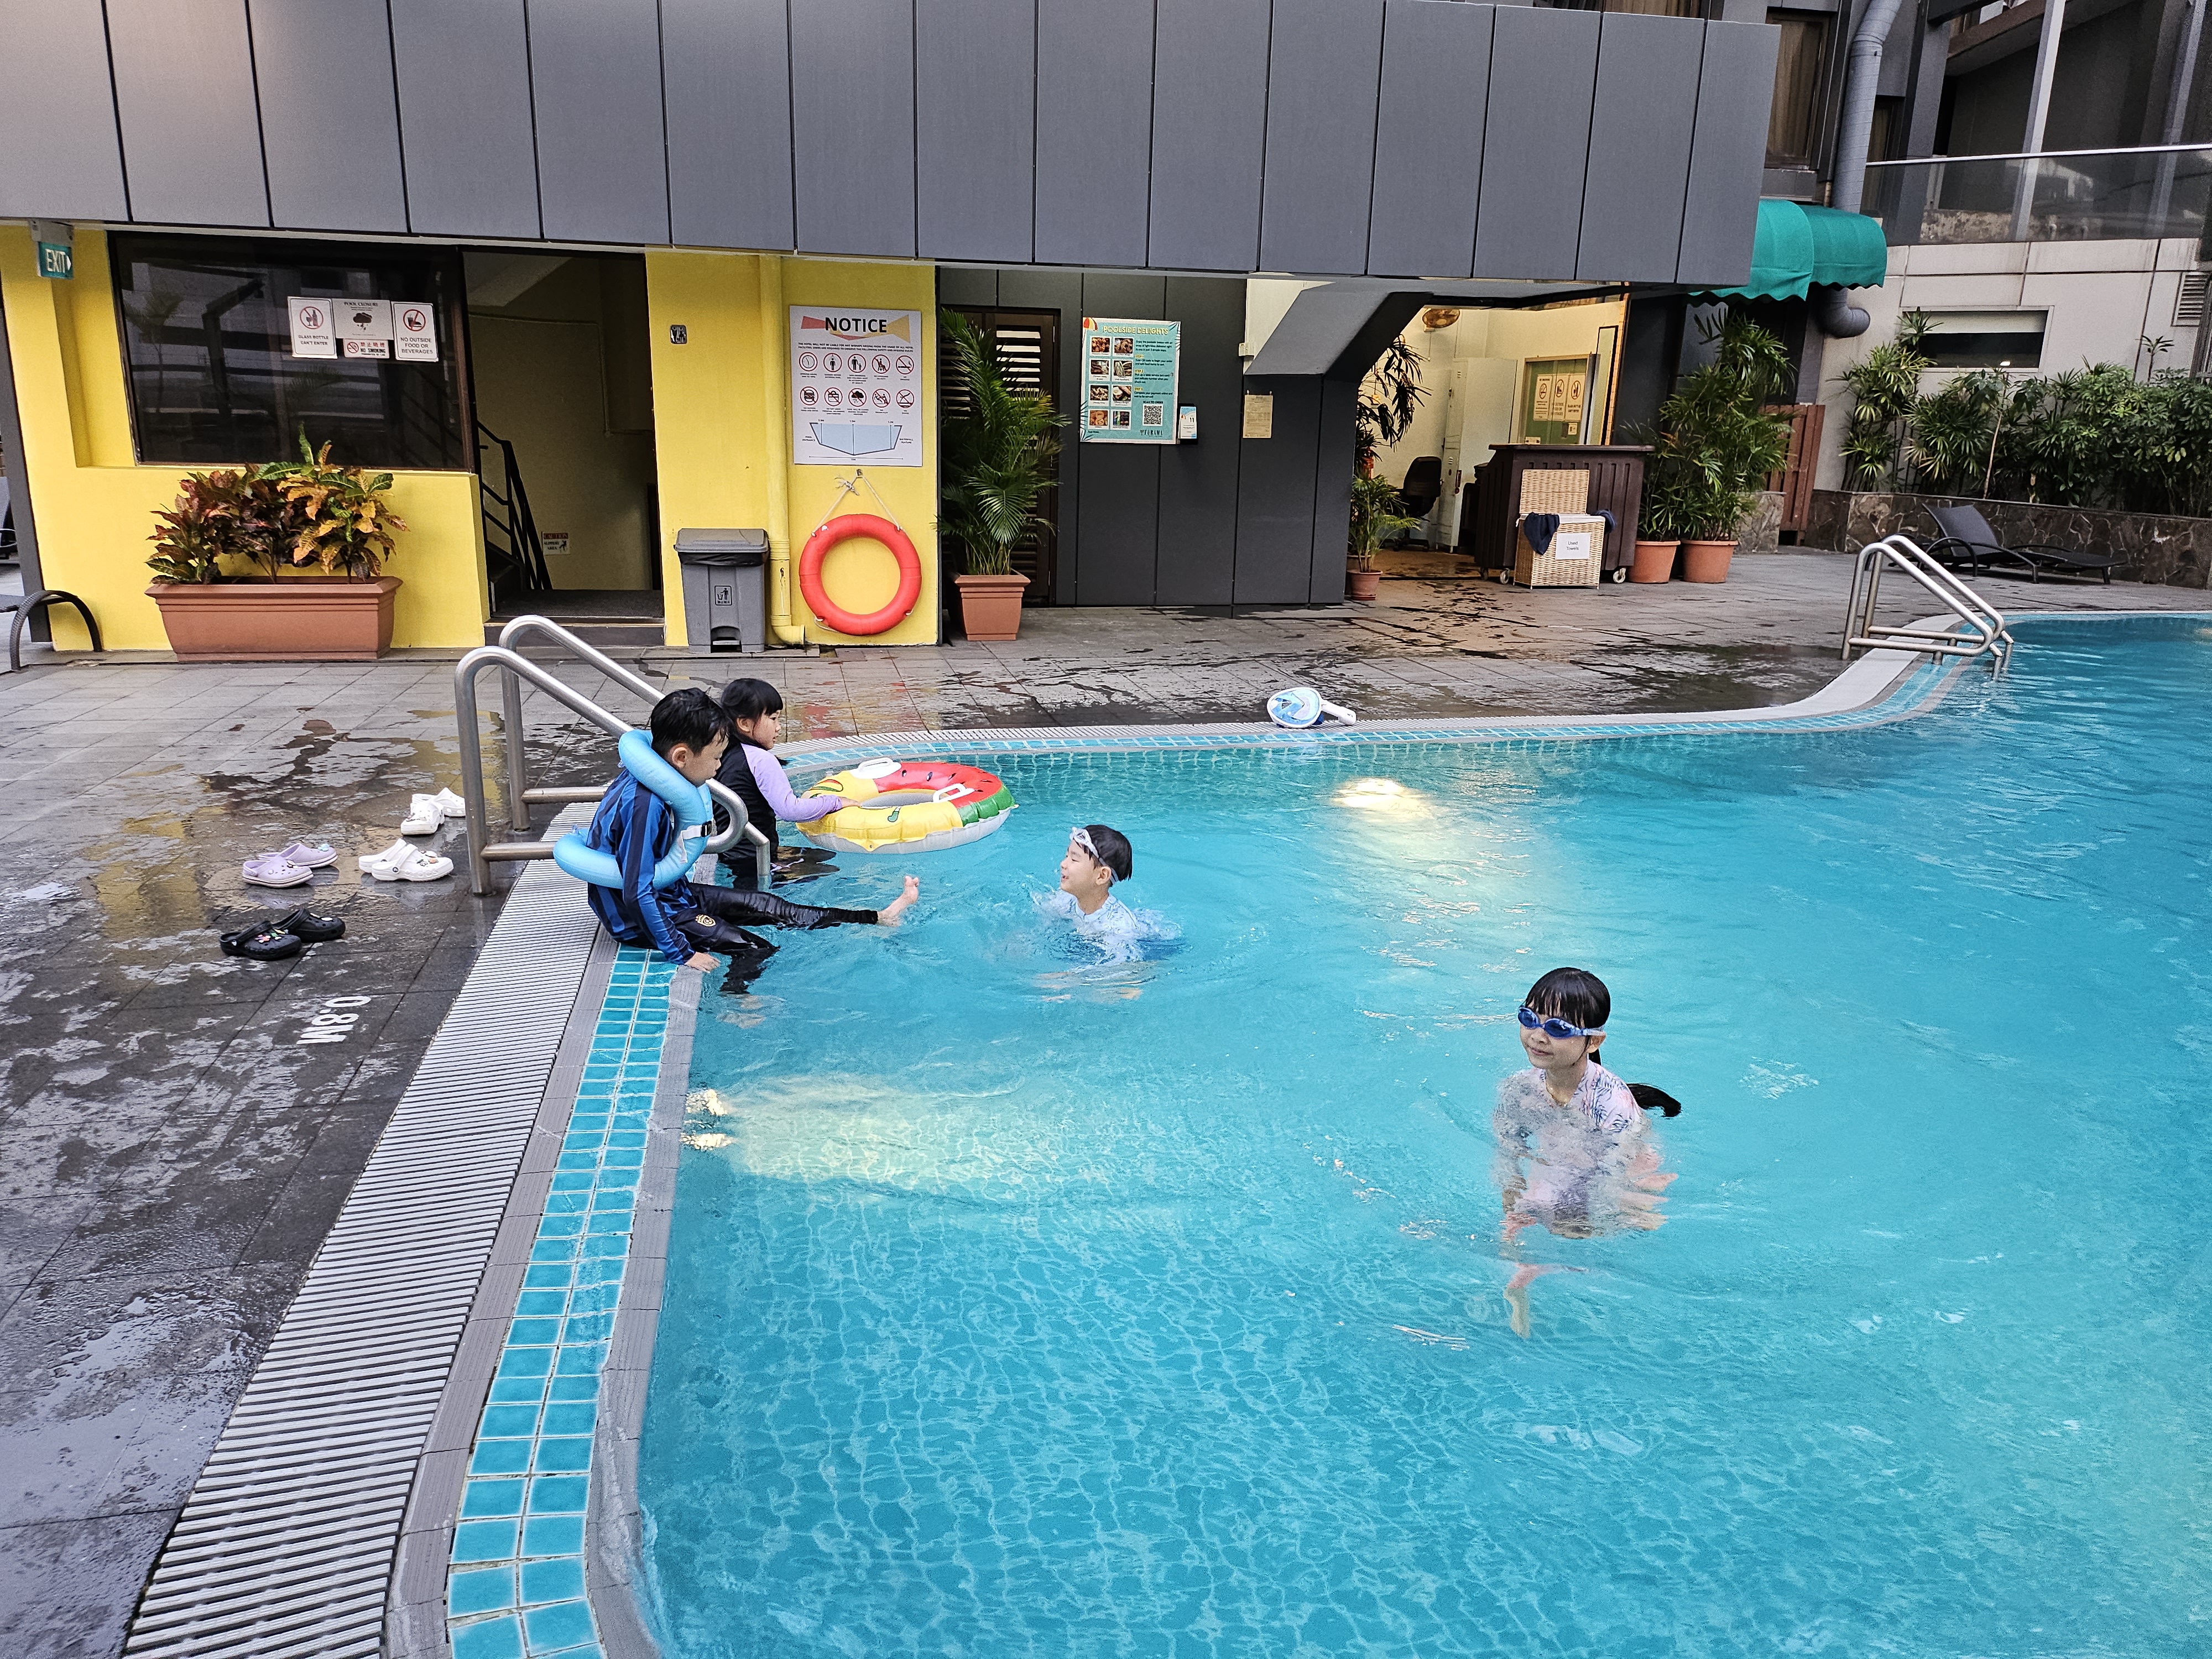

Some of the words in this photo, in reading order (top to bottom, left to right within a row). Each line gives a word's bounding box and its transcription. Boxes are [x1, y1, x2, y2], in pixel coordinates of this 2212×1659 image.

[45, 248, 65, 273] EXIT
[825, 317, 887, 332] NOTICE
[296, 995, 371, 1044] 0.8M
